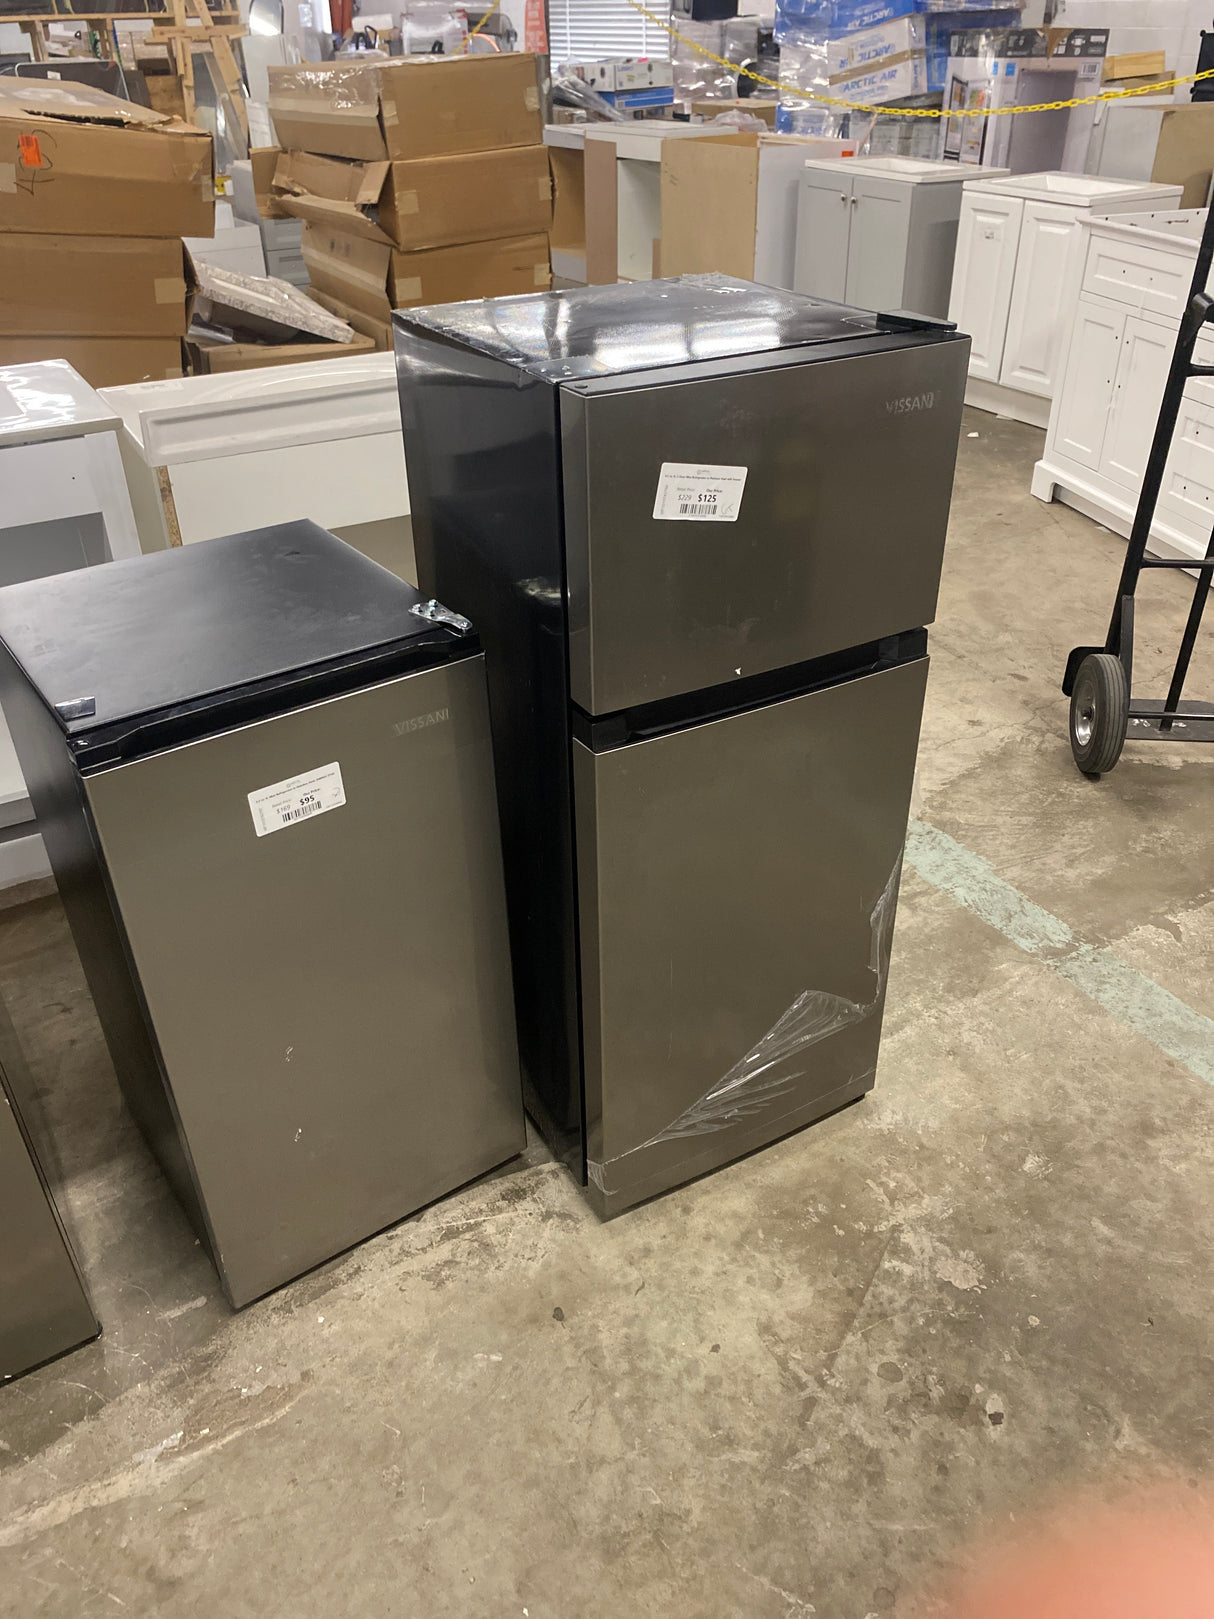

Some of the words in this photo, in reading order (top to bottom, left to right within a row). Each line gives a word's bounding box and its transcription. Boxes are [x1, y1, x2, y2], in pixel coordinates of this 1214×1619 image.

[858, 44, 890, 62] ARCTIC
[843, 75, 877, 92] ARCTIC
[880, 69, 898, 79] AIR
[698, 494, 717, 503] $125
[394, 707, 449, 736] VISSANI
[300, 795, 315, 806] $95
[276, 804, 291, 814] $169
